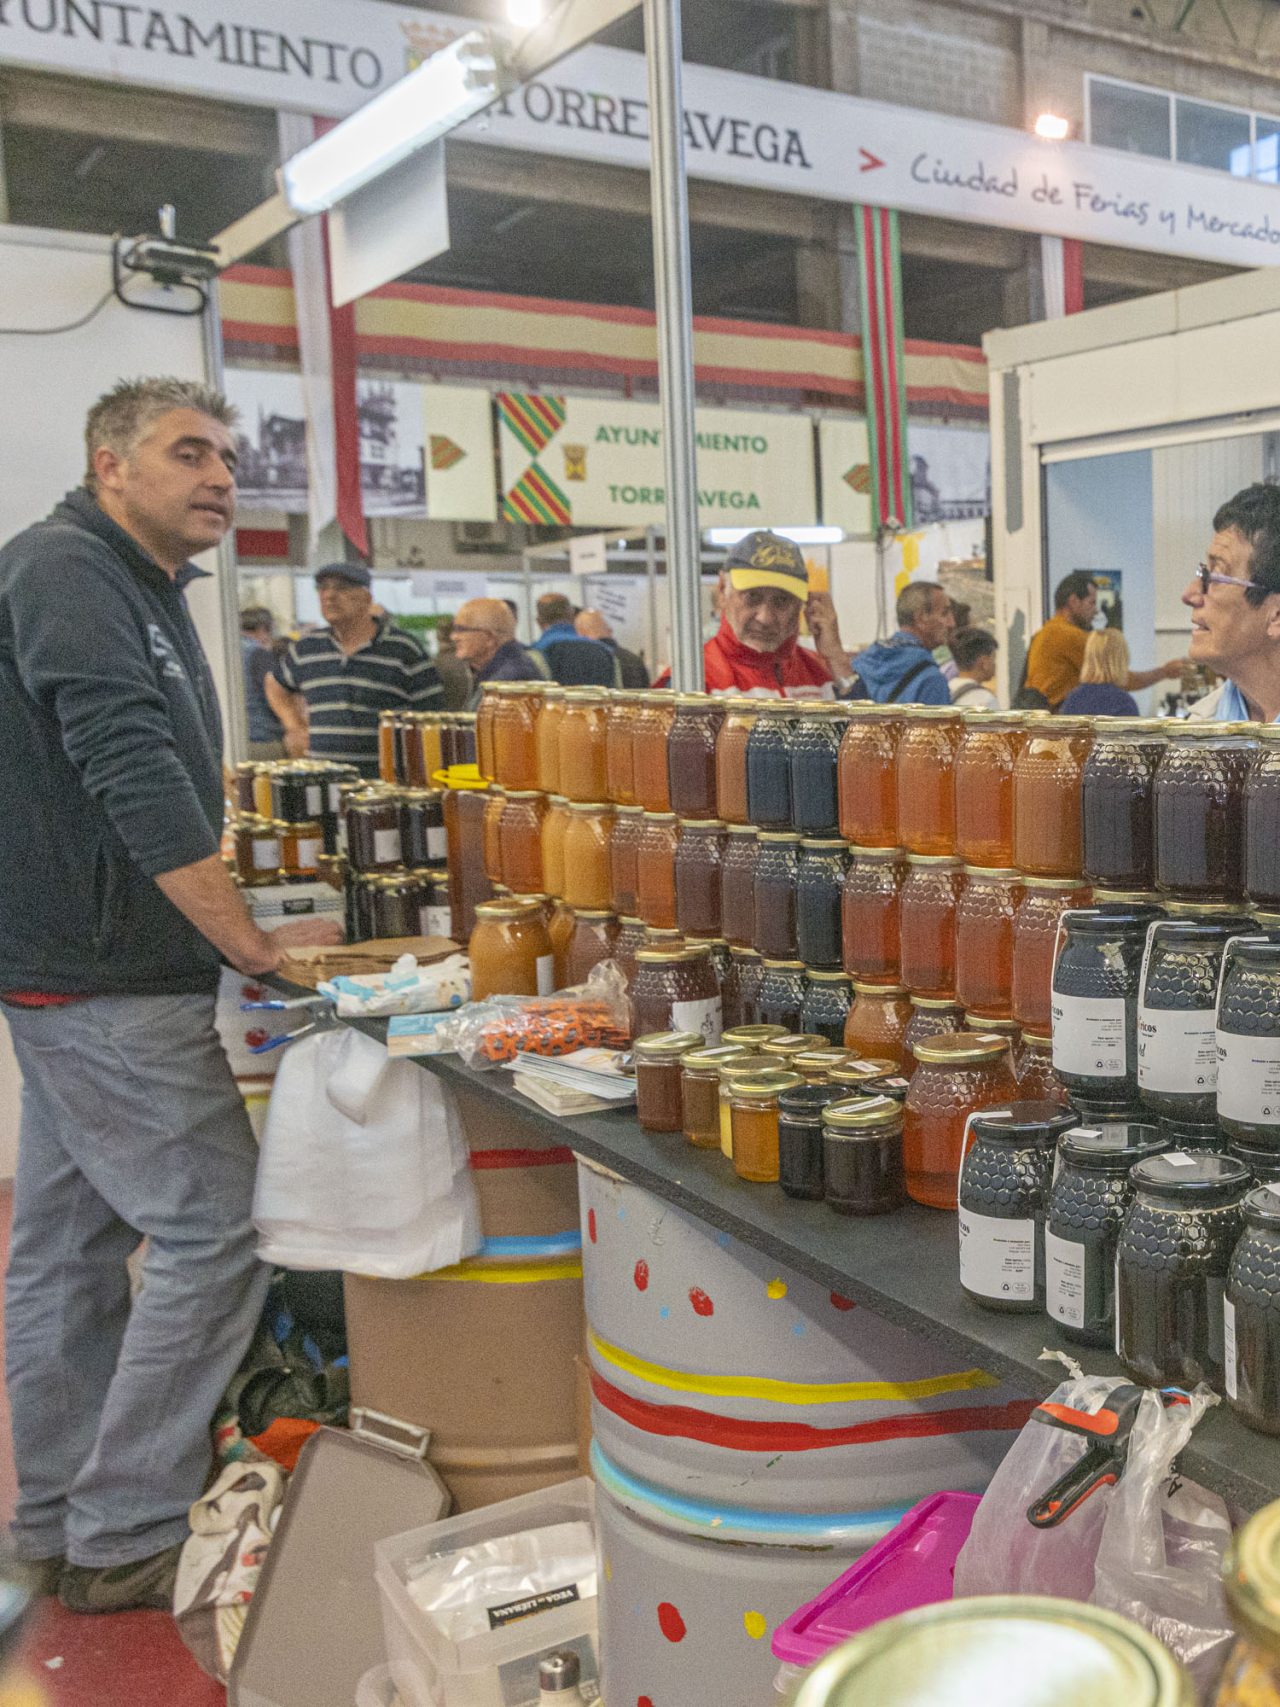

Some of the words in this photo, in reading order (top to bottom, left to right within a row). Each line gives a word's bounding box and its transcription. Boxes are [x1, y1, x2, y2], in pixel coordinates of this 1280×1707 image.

[911, 153, 1018, 197] Ciudad
[1031, 174, 1062, 205] de
[1073, 182, 1150, 226] Ferias
[1159, 206, 1176, 236] y
[545, 1589, 574, 1603] VEGA
